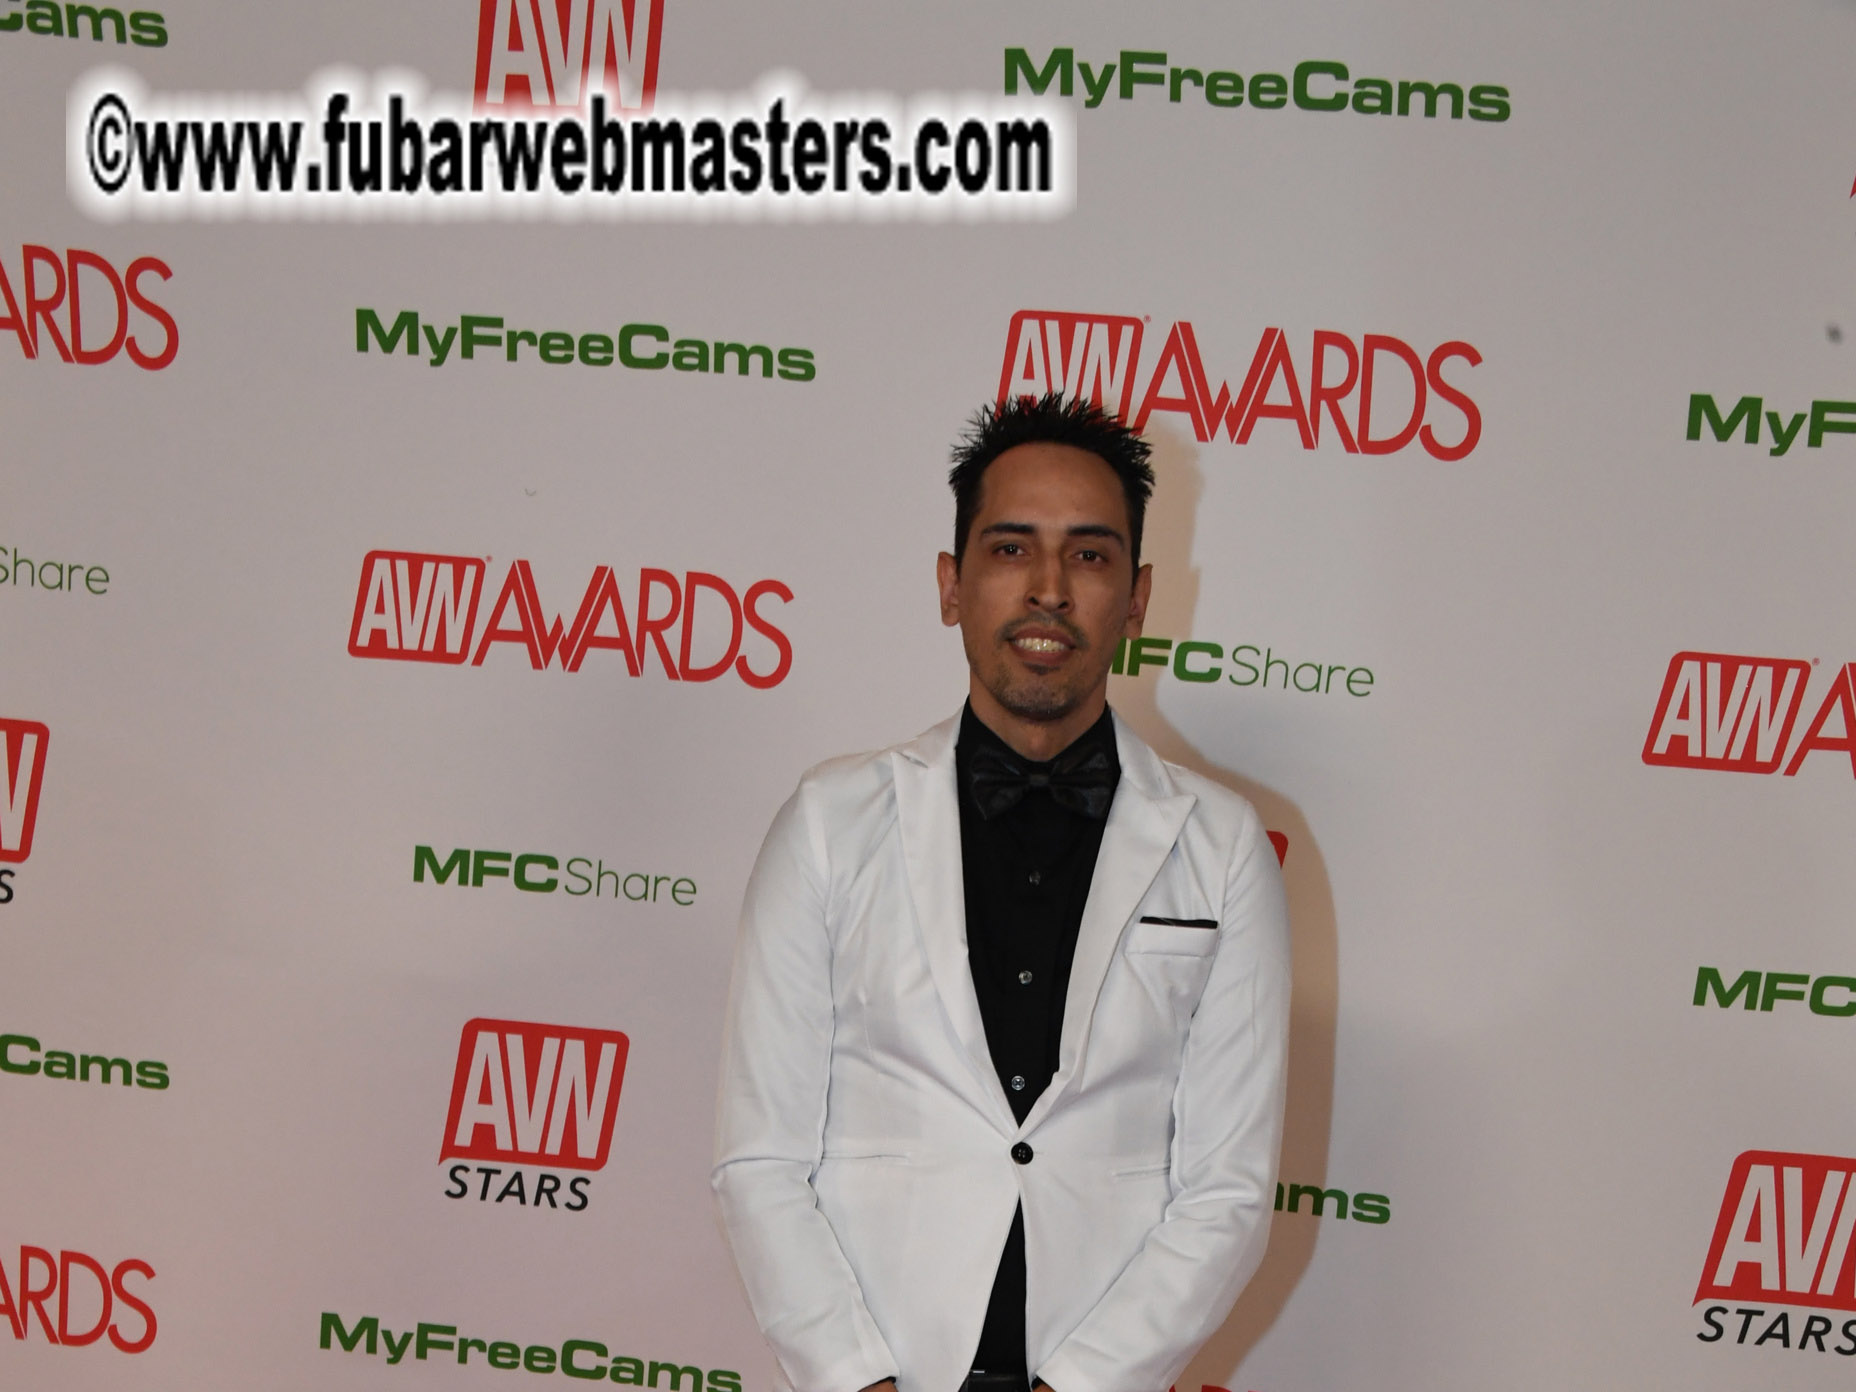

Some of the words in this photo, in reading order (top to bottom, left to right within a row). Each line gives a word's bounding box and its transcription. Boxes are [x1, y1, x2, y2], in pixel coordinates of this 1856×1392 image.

[1004, 47, 1510, 121] MyFreeCams
[356, 307, 817, 381] MyFreeCams
[1130, 320, 1484, 462] AWARDS
[355, 557, 478, 655] AVN
[471, 558, 796, 690] AWARDS
[1650, 659, 1802, 764] AVN
[412, 844, 698, 906] MFCShare
[1693, 965, 1856, 1018] MFC
[453, 1030, 618, 1160] AVN
[444, 1164, 592, 1212] STARS
